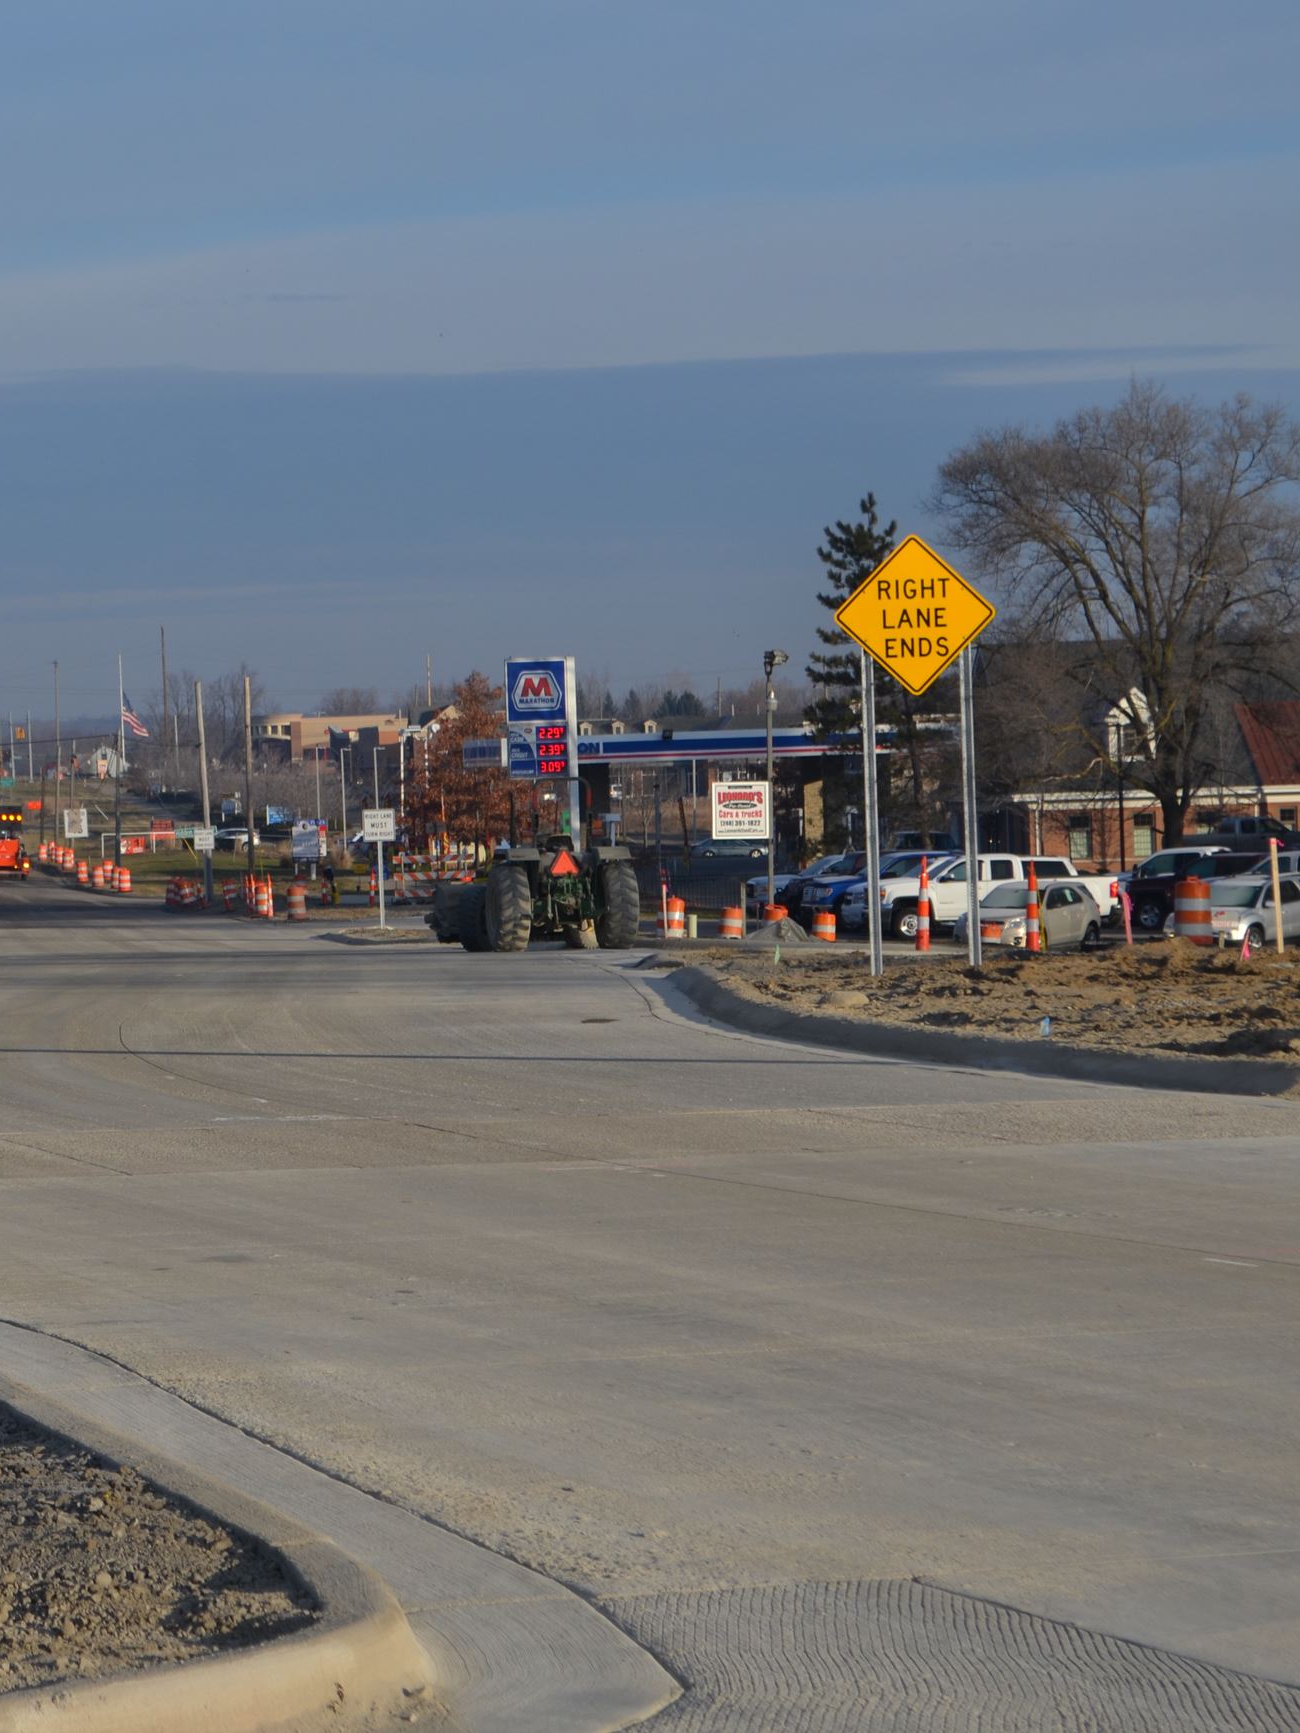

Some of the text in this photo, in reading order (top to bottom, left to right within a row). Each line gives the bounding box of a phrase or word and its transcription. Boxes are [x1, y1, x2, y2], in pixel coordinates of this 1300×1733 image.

[877, 578, 949, 600] RIGHT
[882, 608, 947, 629] LANE
[885, 637, 949, 658] ENDS
